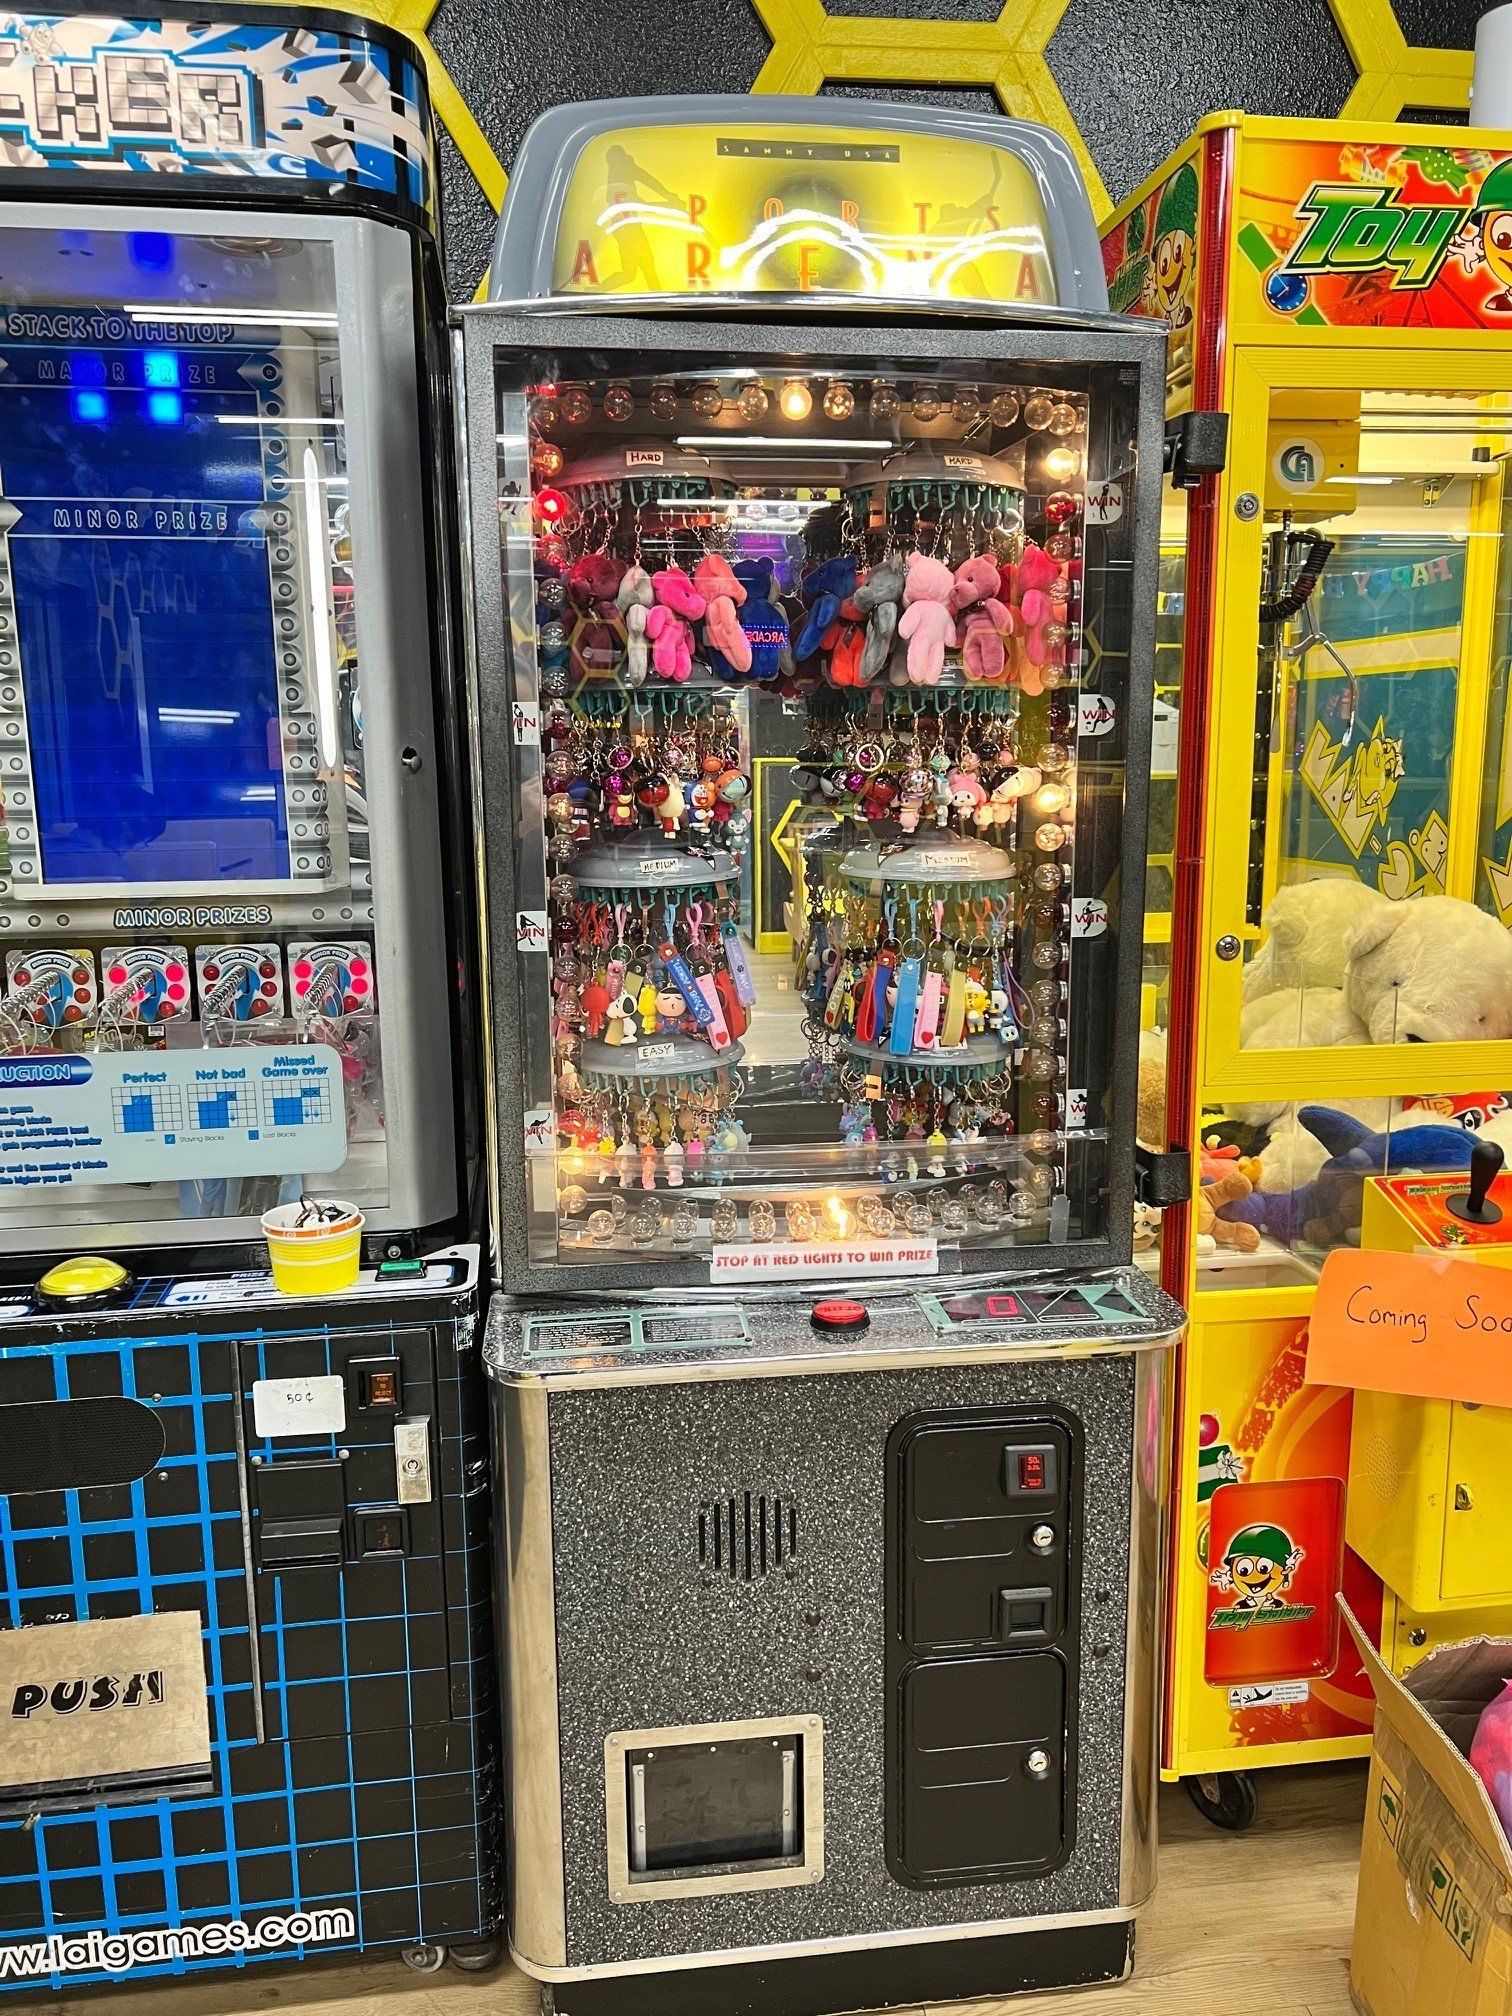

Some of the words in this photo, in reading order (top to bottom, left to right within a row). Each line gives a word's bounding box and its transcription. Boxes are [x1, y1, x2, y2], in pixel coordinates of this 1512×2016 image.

[723, 145, 813, 156] SAMMY
[844, 150, 891, 159] USA
[1285, 183, 1468, 288] Toy
[8, 313, 87, 338] STACK
[91, 316, 125, 340] TO
[130, 320, 178, 341] THE
[183, 322, 233, 343] TOP
[630, 452, 661, 463] HARD
[1087, 496, 1122, 507] WIN
[54, 509, 139, 529] MINOR
[155, 511, 228, 530] PRIZE
[1082, 709, 1116, 719] WIN
[115, 907, 191, 928] MINOR
[196, 904, 271, 925] PRIZES
[1075, 913, 1109, 923] WIN
[642, 1045, 672, 1058] EASY
[274, 1055, 315, 1067] Missed
[123, 1072, 167, 1084] Perfect
[196, 1069, 218, 1081] Not
[222, 1068, 245, 1079] bad
[262, 1066, 299, 1078] Game
[302, 1066, 329, 1076] over
[716, 1255, 749, 1268] STOP
[753, 1255, 769, 1266] AT
[773, 1254, 799, 1266] RED
[803, 1252, 842, 1265] LIGHTS
[846, 1252, 865, 1263] TO
[869, 1251, 894, 1262] WIN
[898, 1249, 932, 1262] PRIZE
[1346, 1285, 1427, 1343] Coming
[1208, 1606, 1256, 1631] Toy
[1251, 1603, 1316, 1623] Soldier
